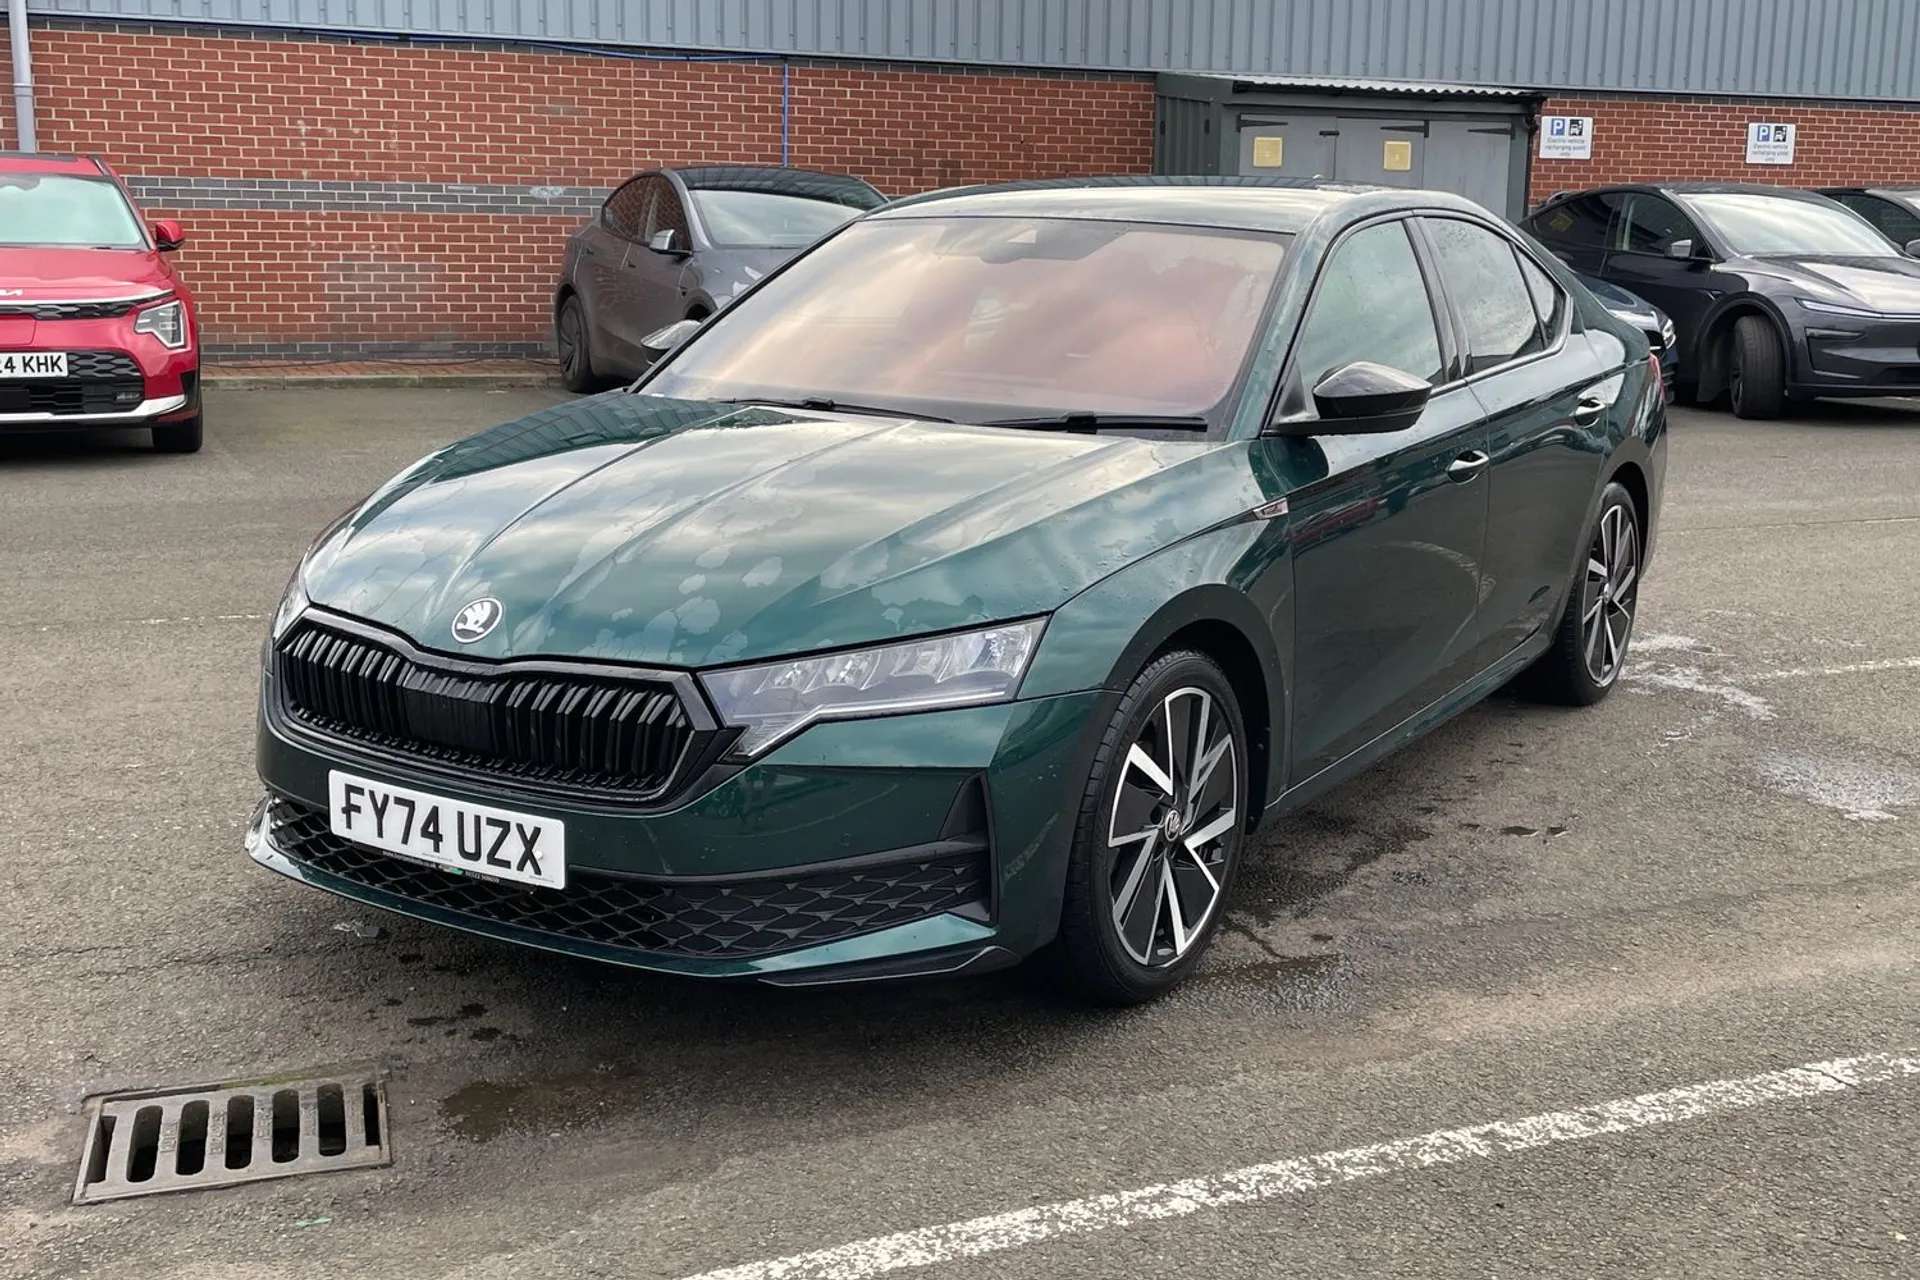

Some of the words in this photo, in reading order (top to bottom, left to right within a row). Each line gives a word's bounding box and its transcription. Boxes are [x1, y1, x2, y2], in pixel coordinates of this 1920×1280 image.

[22, 355, 63, 373] KHK
[341, 783, 443, 853] FY74
[456, 810, 542, 876] UZX
